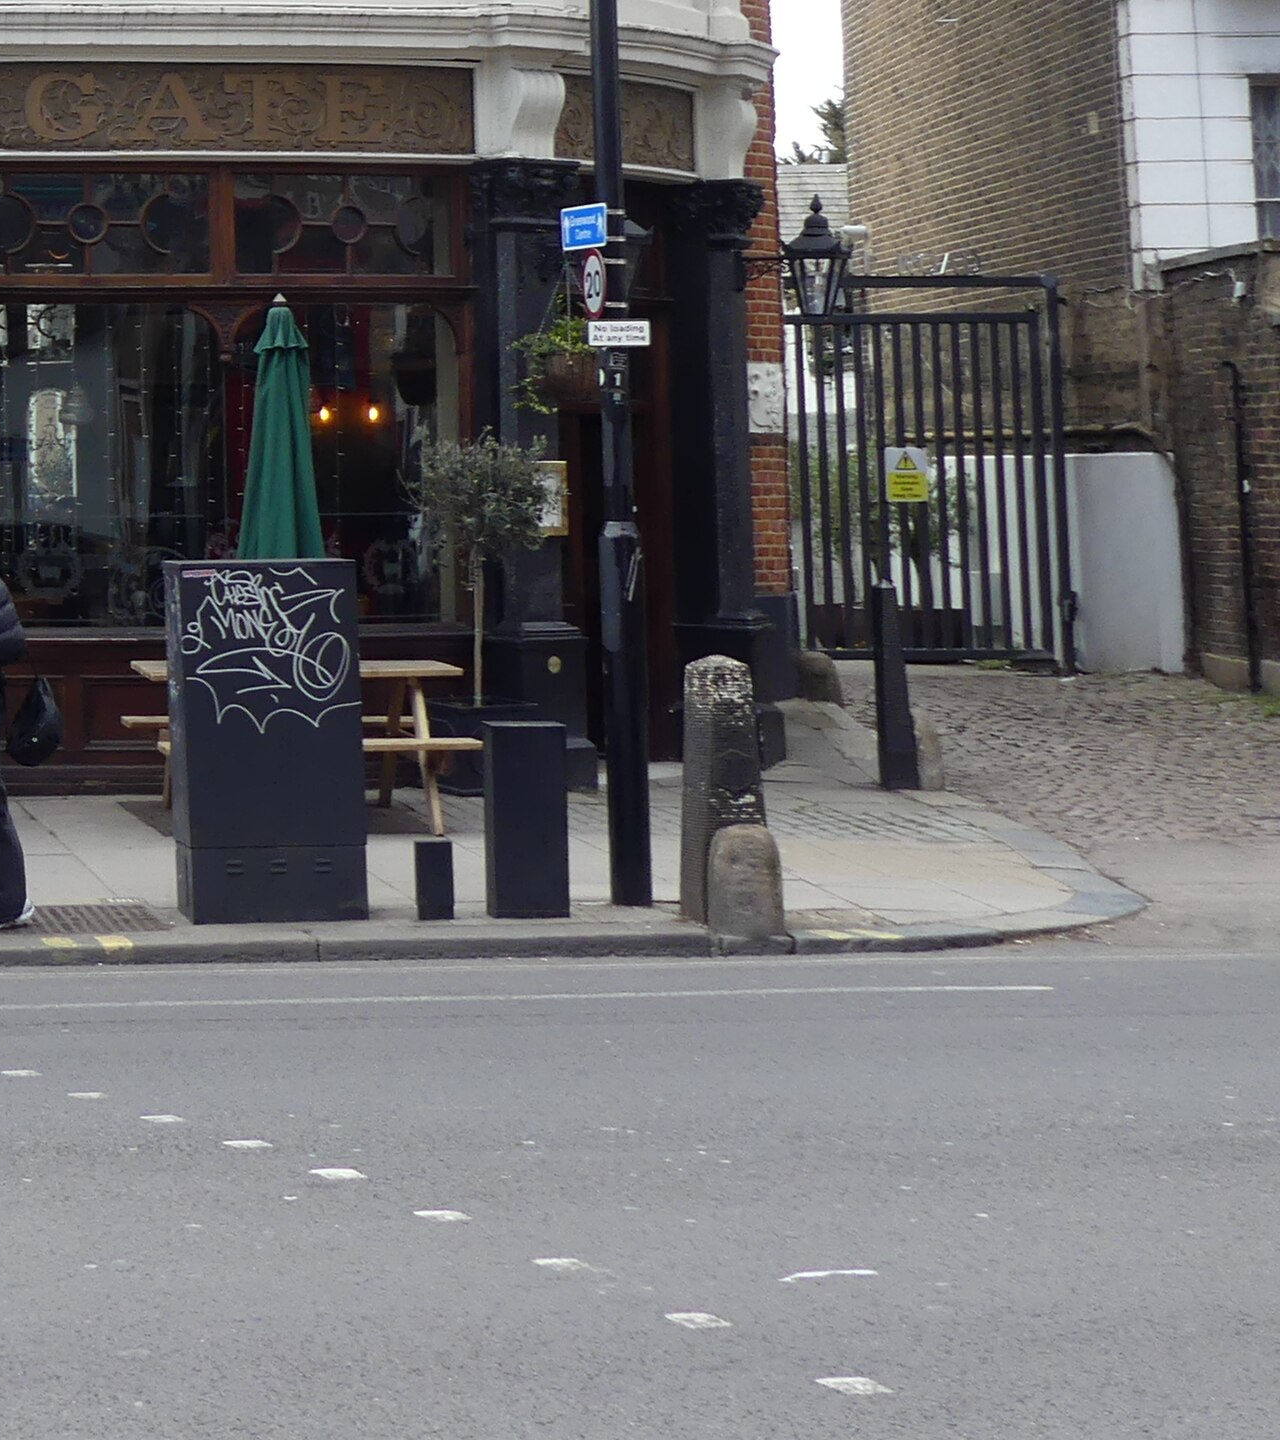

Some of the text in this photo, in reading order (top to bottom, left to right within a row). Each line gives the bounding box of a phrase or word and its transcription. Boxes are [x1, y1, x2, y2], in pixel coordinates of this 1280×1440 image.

[24, 71, 388, 145] GATE
[585, 271, 601, 298] 20
[594, 324, 645, 333] No loading
[607, 335, 622, 343] any
